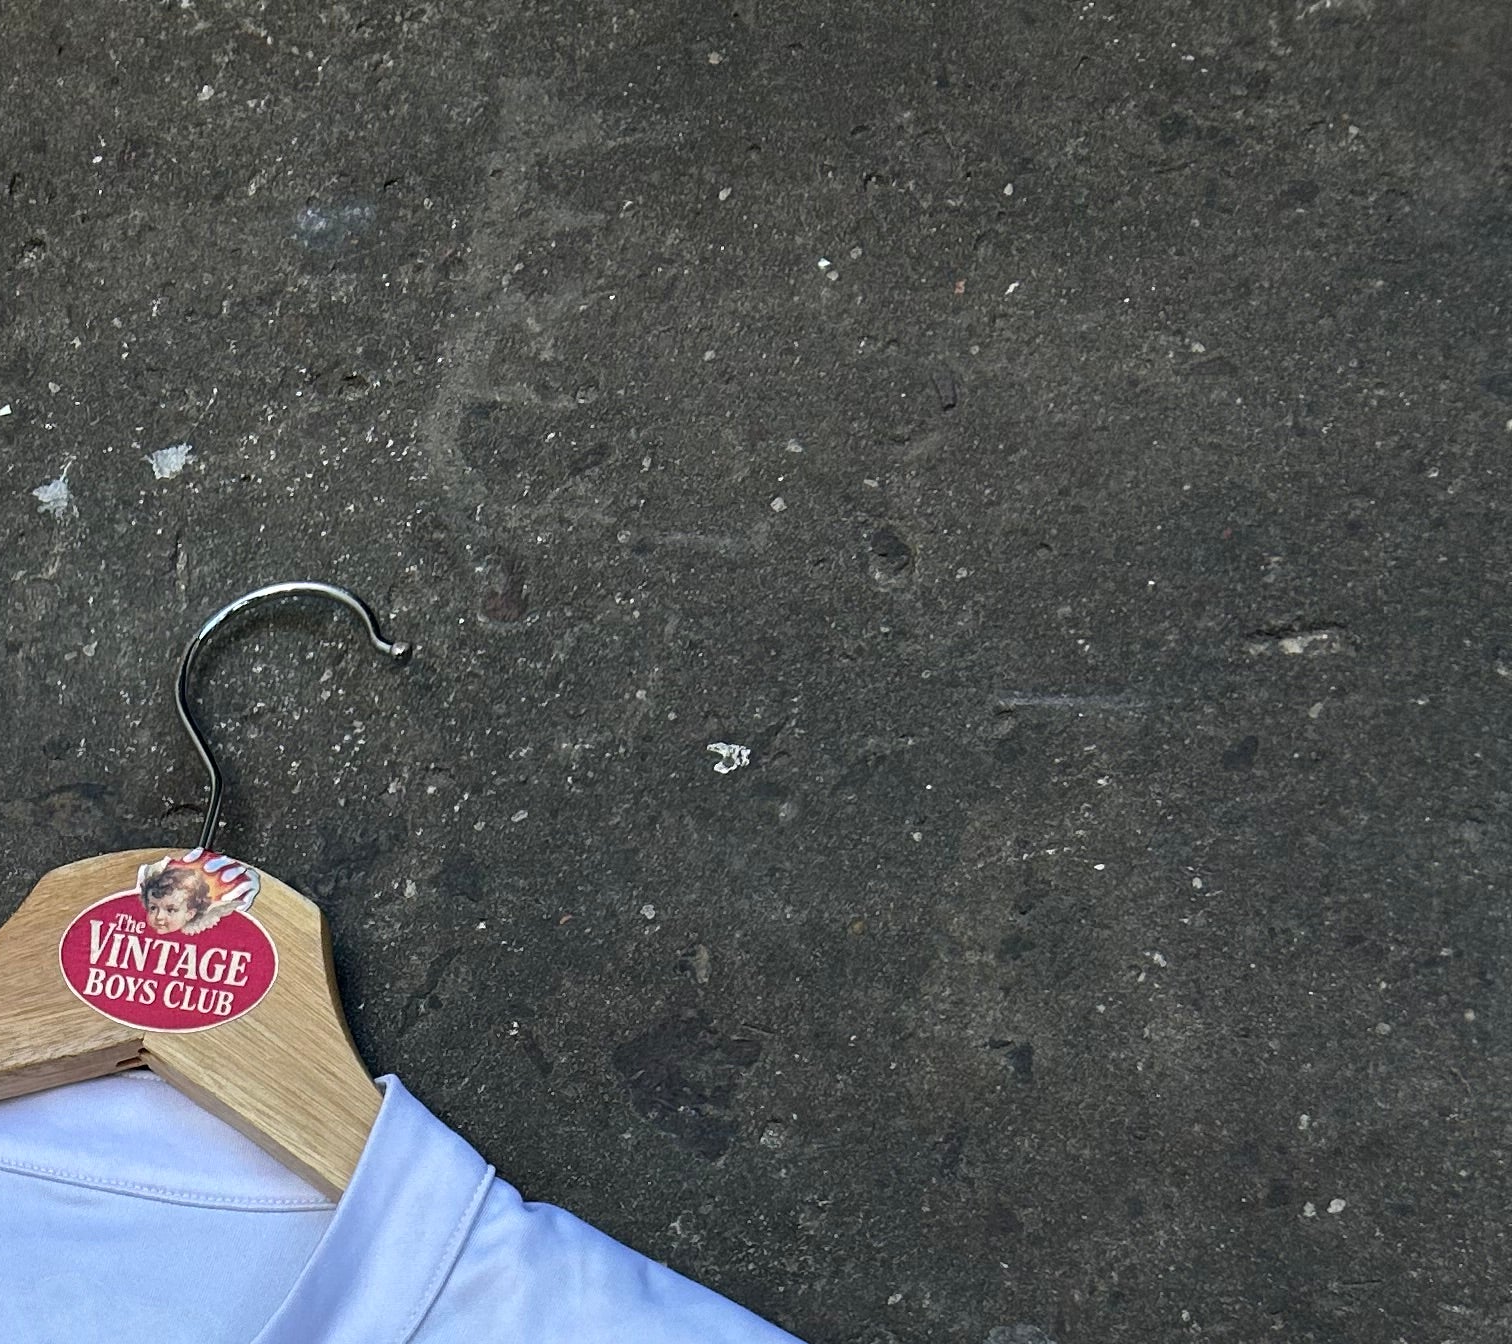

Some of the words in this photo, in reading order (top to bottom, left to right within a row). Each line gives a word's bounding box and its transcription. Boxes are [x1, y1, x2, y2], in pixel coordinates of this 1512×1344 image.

[115, 913, 146, 934] The
[90, 920, 251, 986] VINTAGE
[83, 968, 158, 1005] BOYS
[164, 982, 234, 1016] CLUB
